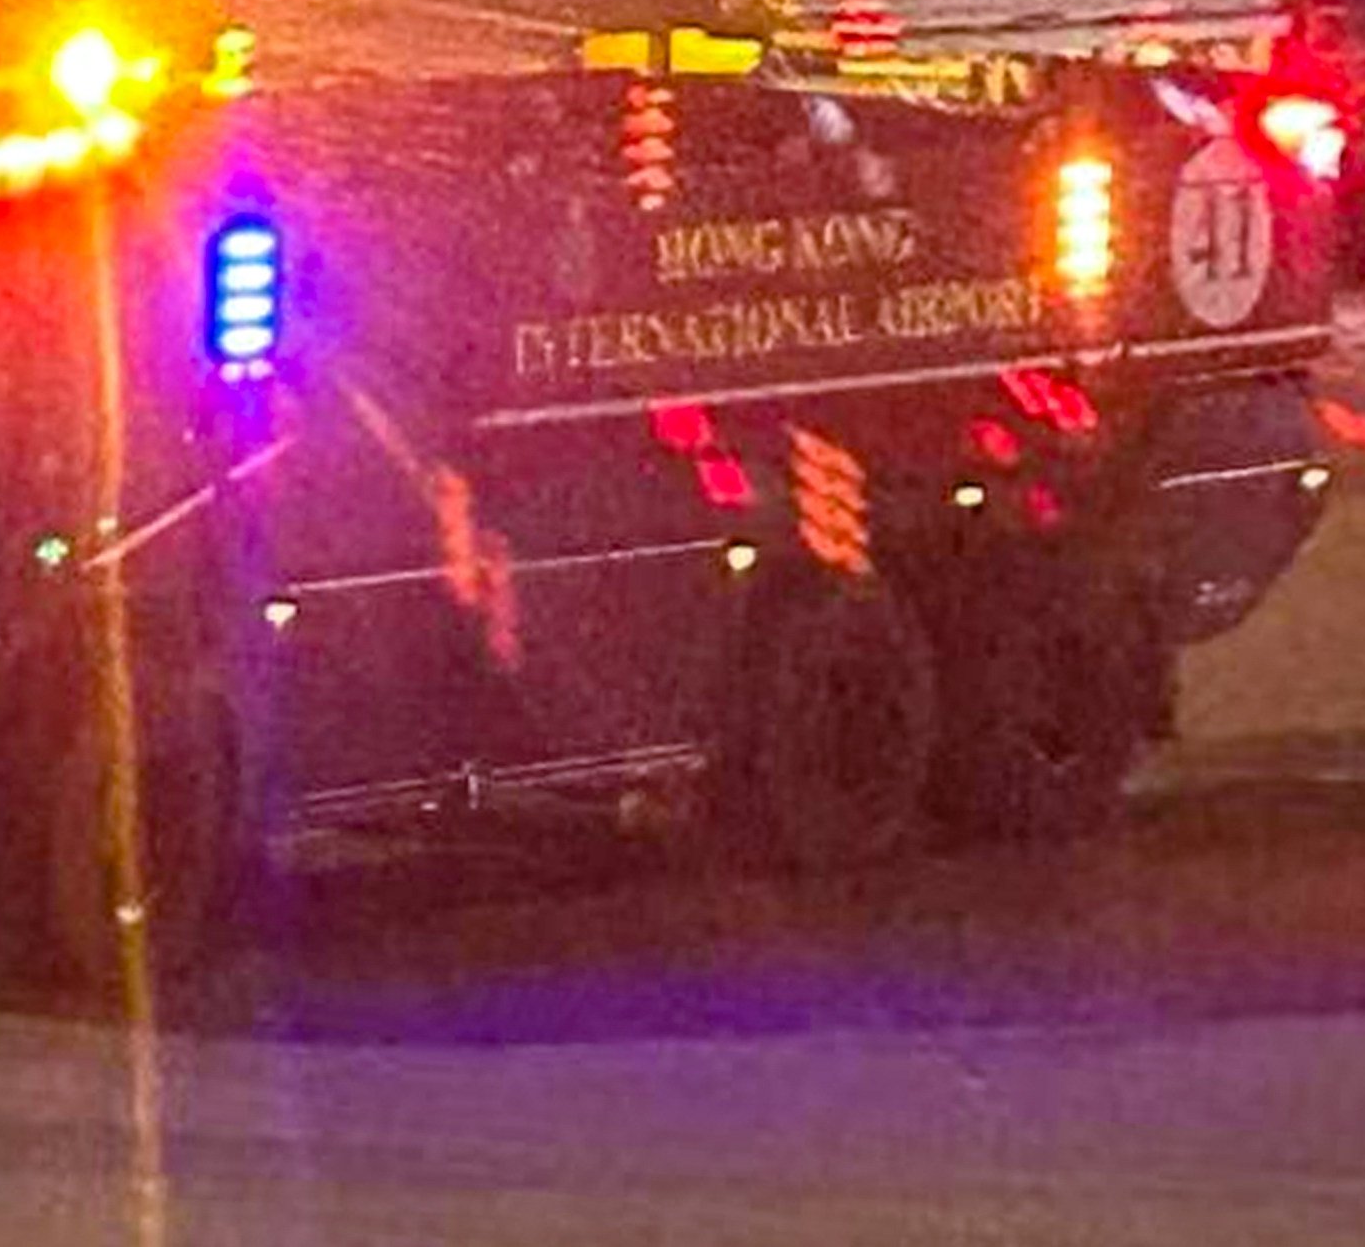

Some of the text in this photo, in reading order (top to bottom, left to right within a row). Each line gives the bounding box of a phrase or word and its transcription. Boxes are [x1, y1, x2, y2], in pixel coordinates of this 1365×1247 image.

[655, 210, 918, 283] HONG KONG
[515, 278, 1041, 373] INTERNATIONAL AIRPORT
